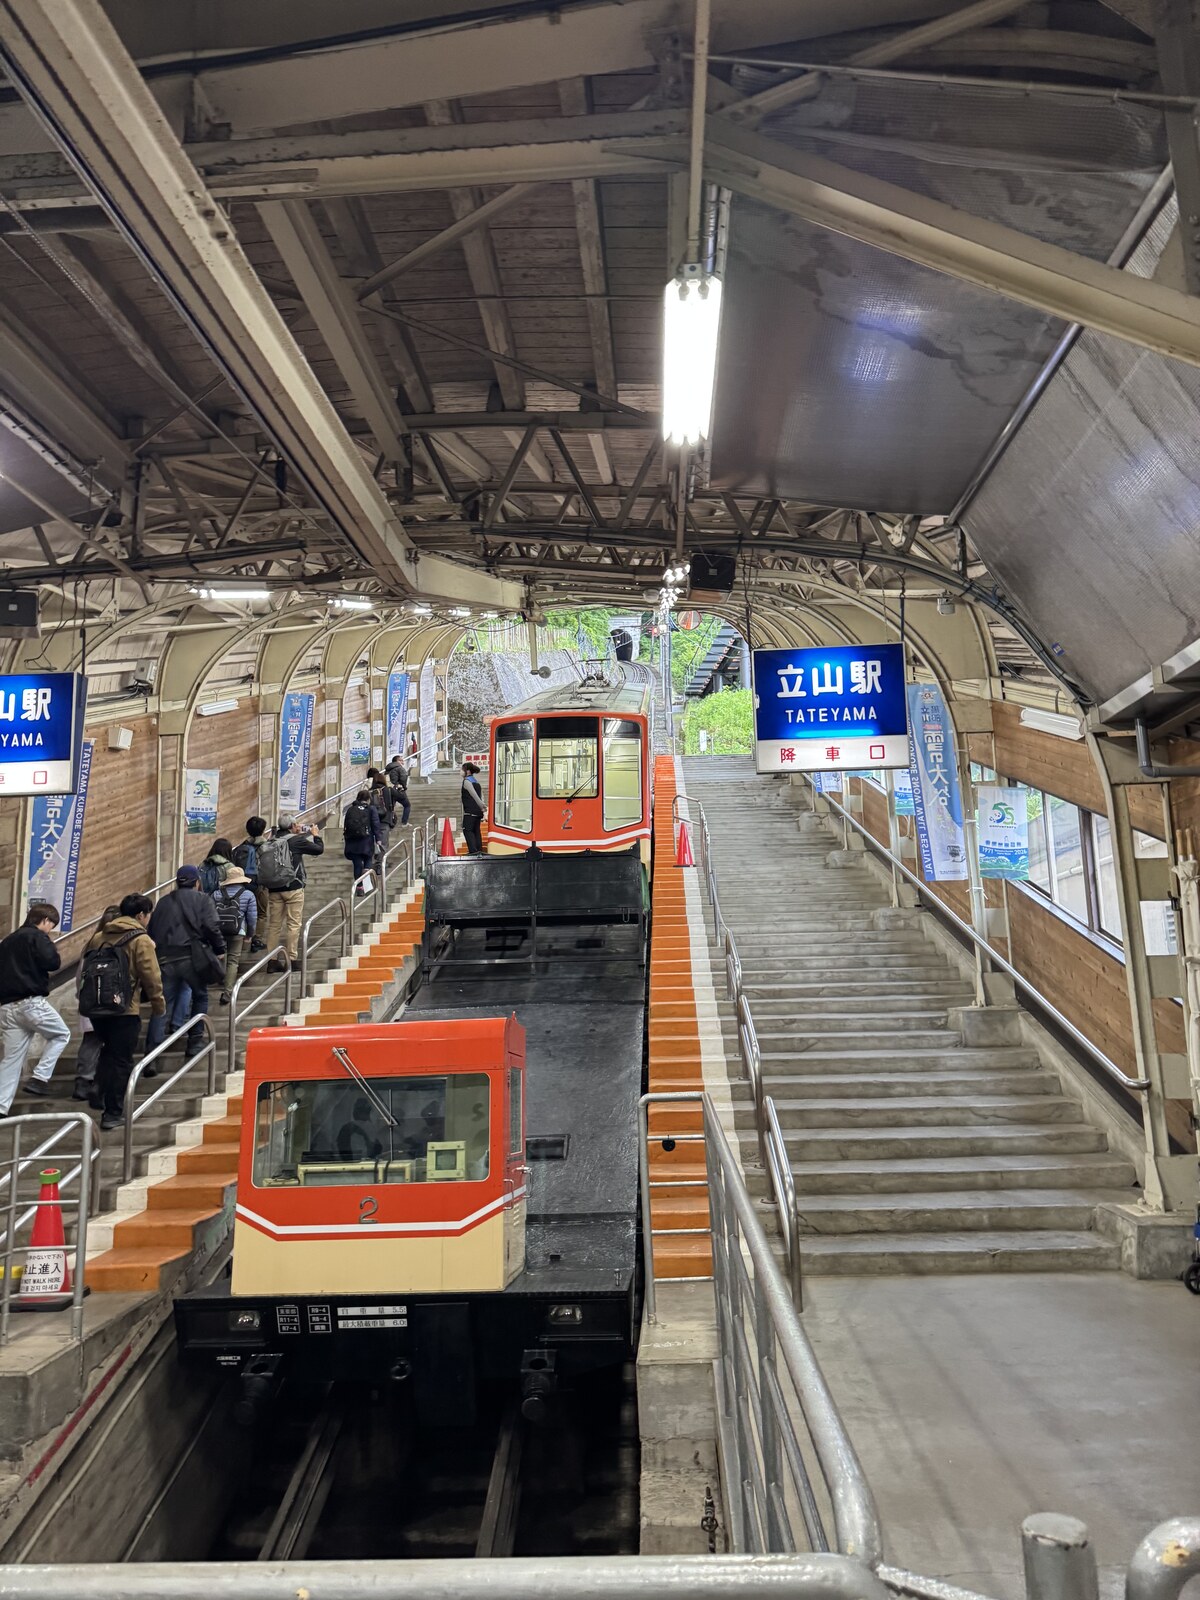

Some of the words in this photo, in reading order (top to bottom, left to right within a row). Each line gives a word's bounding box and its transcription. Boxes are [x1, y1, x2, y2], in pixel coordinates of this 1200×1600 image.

[776, 660, 882, 698] 立山駅
[306, 698, 314, 726] TATEYAMA
[785, 706, 878, 724] TATEYAMA
[780, 744, 886, 764] 降車口
[78, 748, 91, 794] TATEYAMA
[74, 796, 86, 830] KUROBE
[561, 809, 573, 830] 2
[70, 831, 81, 858] SNOW
[68, 860, 78, 884] WALL
[62, 886, 74, 926] FESTIVAL
[358, 1196, 379, 1225] 2
